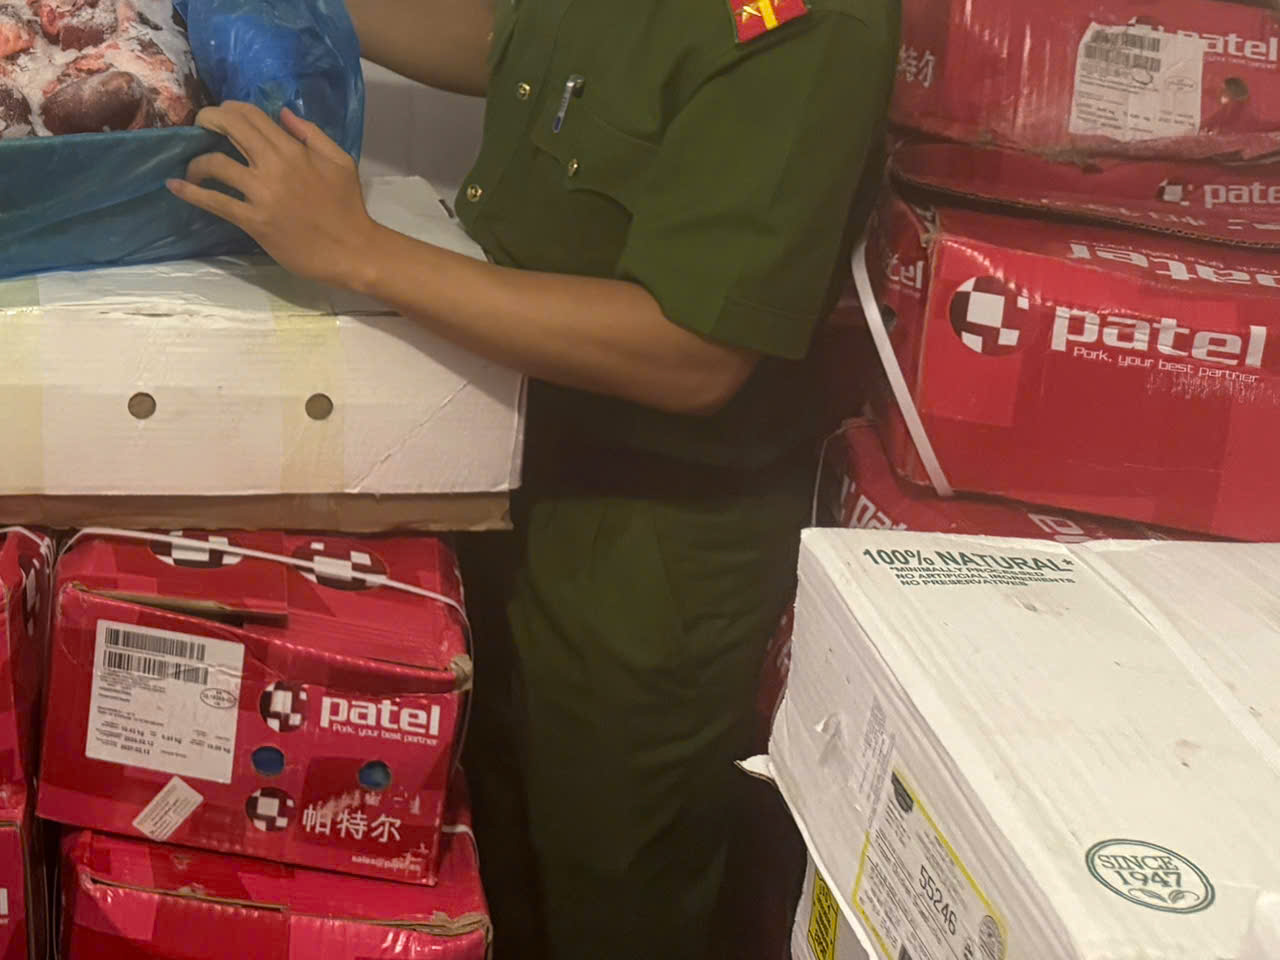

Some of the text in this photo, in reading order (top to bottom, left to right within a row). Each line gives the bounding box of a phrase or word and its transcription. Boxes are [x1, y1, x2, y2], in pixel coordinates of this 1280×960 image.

[1203, 181, 1280, 208] pate
[886, 253, 924, 289] tel
[1051, 305, 1267, 368] patel
[1118, 354, 1154, 368] your
[1158, 358, 1194, 374] best
[1198, 366, 1259, 383] partner
[862, 548, 935, 566] 100%
[320, 695, 440, 736] patel
[358, 727, 379, 738] your
[403, 734, 439, 747] partner
[302, 803, 401, 843] 帕特尔
[1098, 854, 1180, 871] SINCE
[1114, 870, 1183, 888] 1947
[919, 864, 958, 936] 55246
